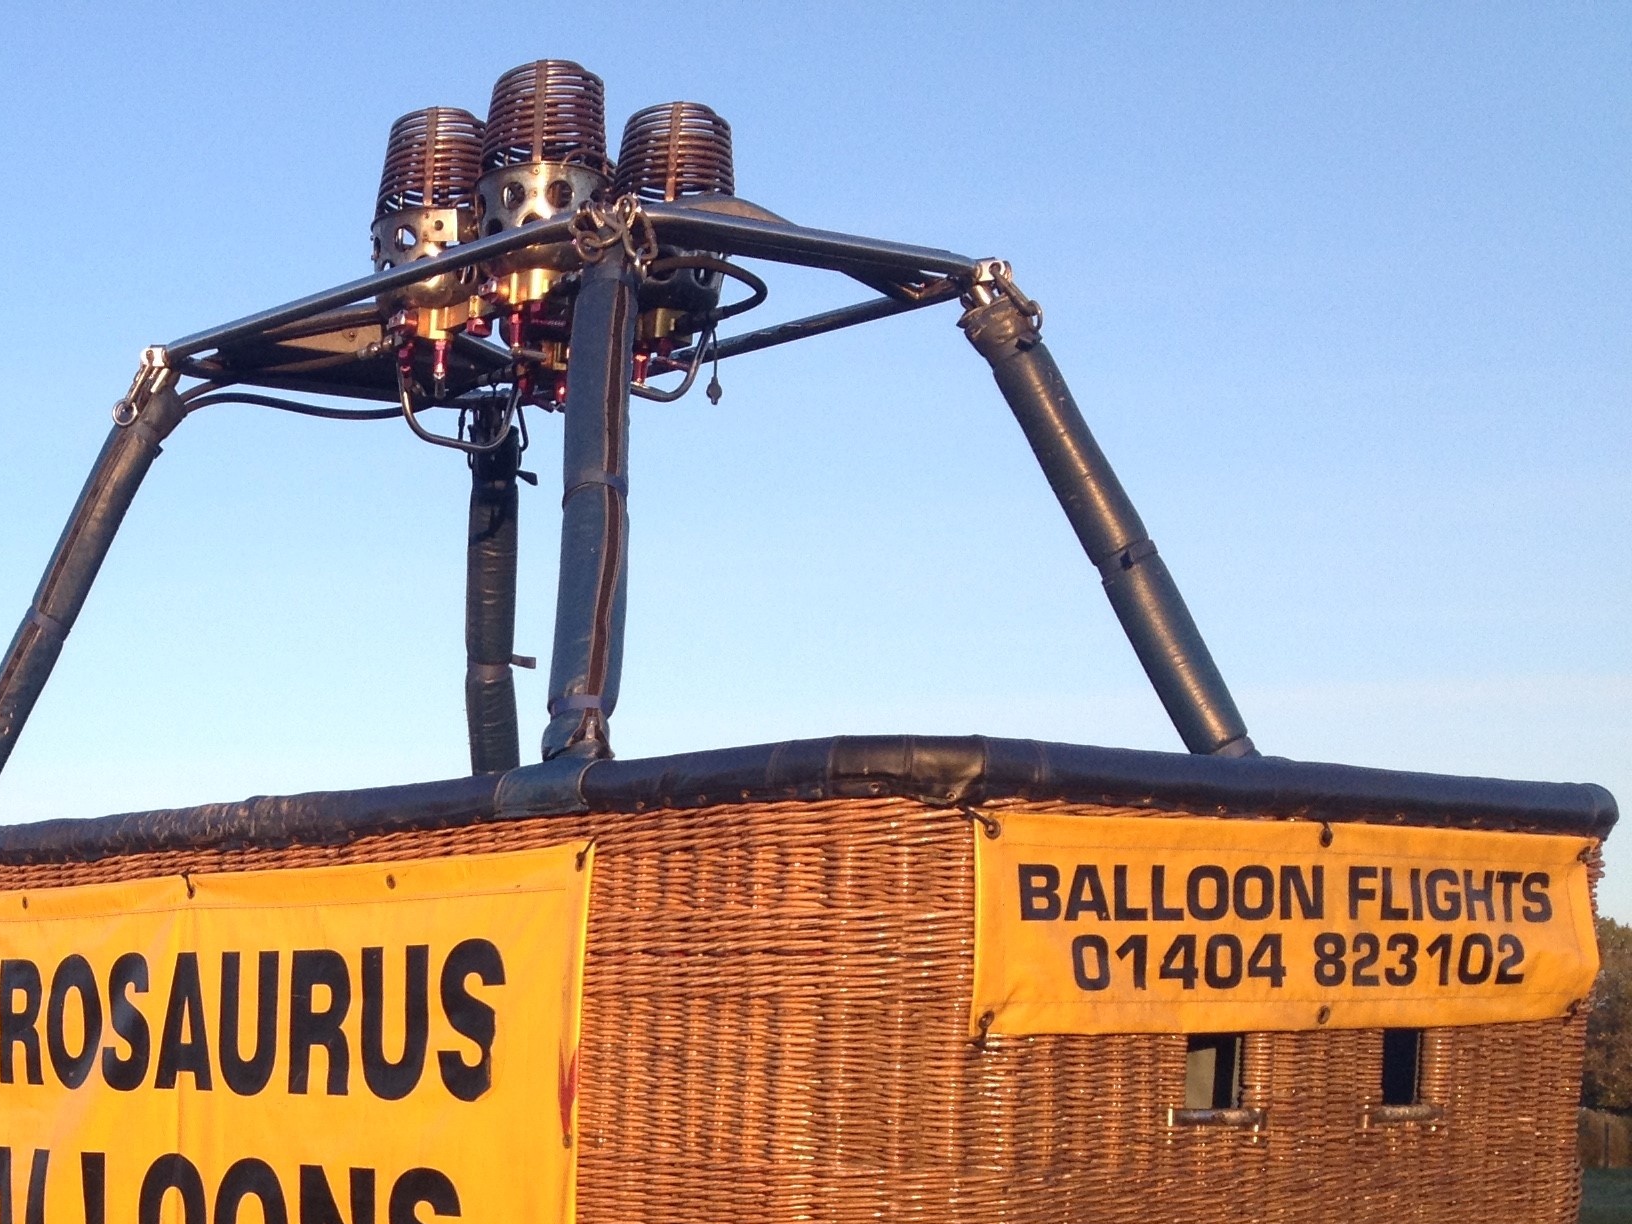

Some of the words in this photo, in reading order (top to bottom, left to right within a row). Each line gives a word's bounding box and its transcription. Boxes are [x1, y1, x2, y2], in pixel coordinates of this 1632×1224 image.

[1018, 863, 1325, 922] BALLOON
[1348, 866, 1553, 923] FLIGHTS
[1071, 932, 1287, 991] 01404
[1313, 932, 1526, 988] 823102
